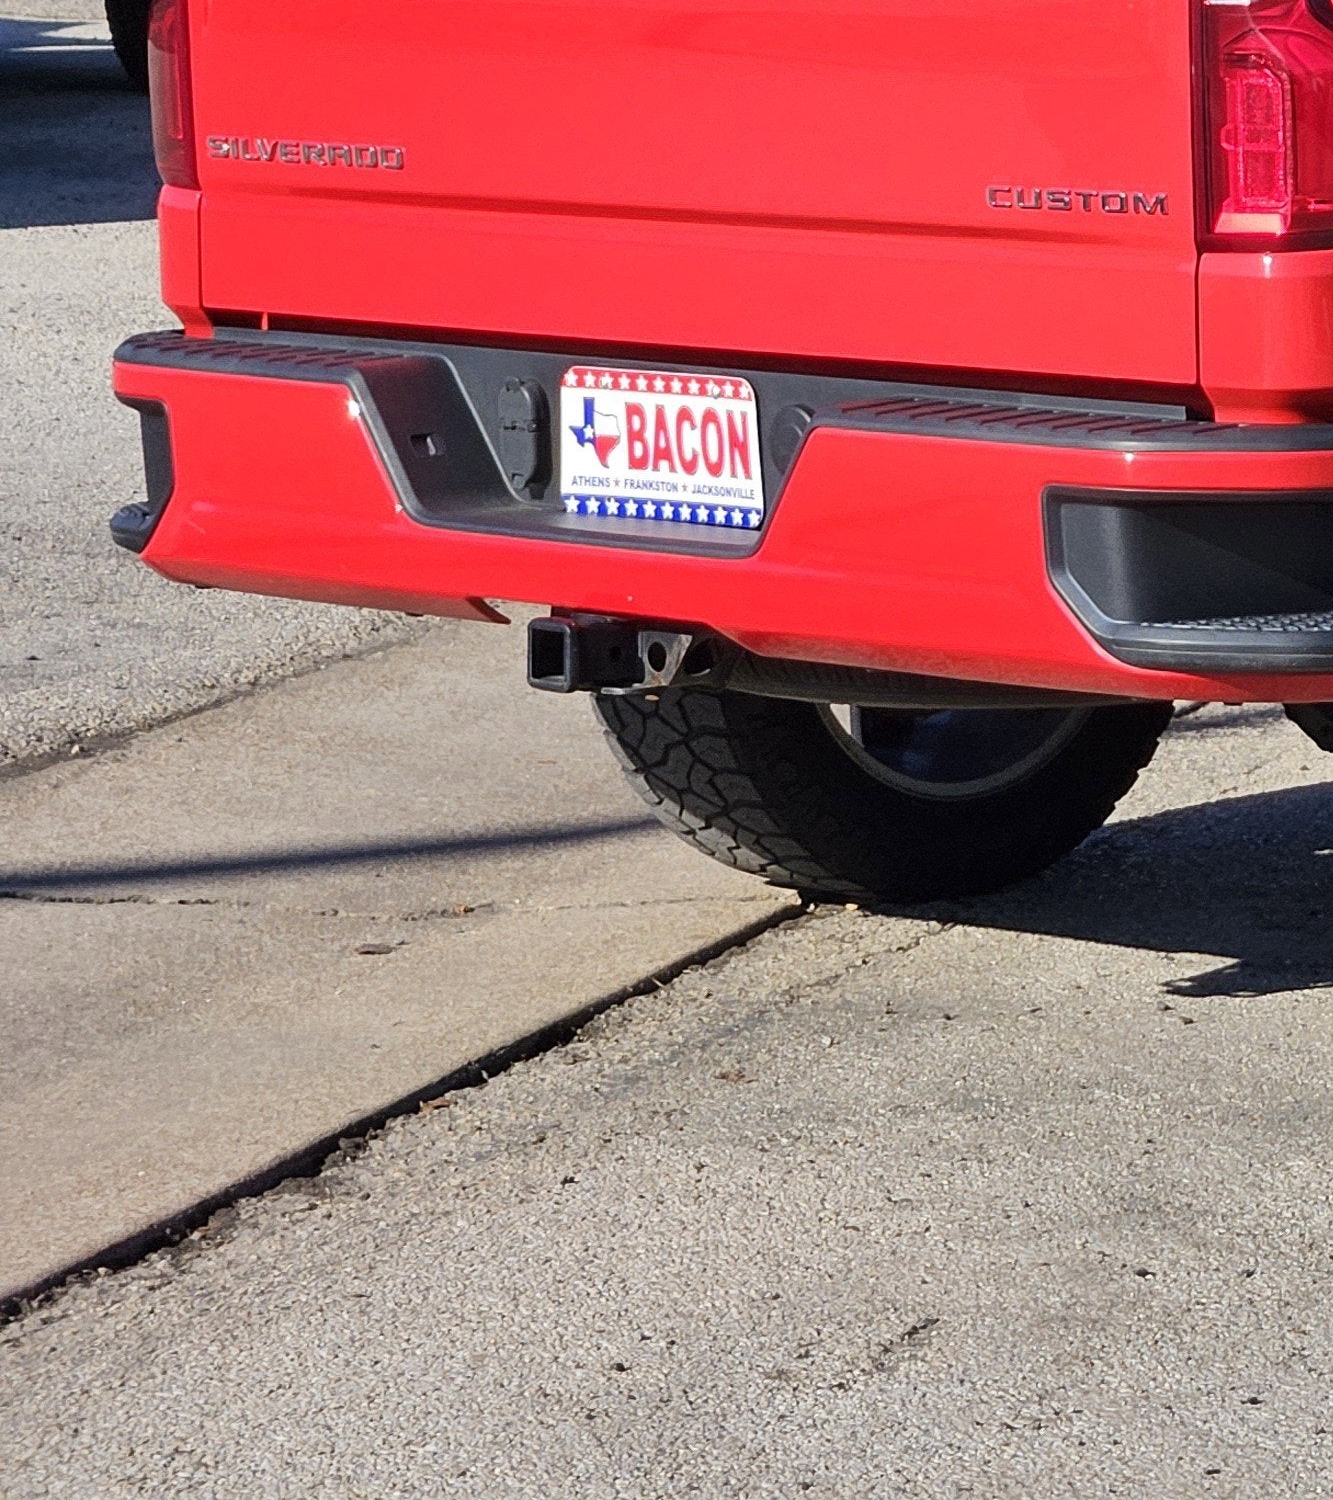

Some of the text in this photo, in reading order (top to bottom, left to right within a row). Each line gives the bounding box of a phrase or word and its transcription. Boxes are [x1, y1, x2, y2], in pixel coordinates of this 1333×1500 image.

[207, 134, 406, 171] SILVERADO
[987, 185, 1170, 216] CUSTOM
[624, 401, 753, 481] BACON
[571, 475, 755, 501] ATHENS FRANKSTON JACKSONVILLE
